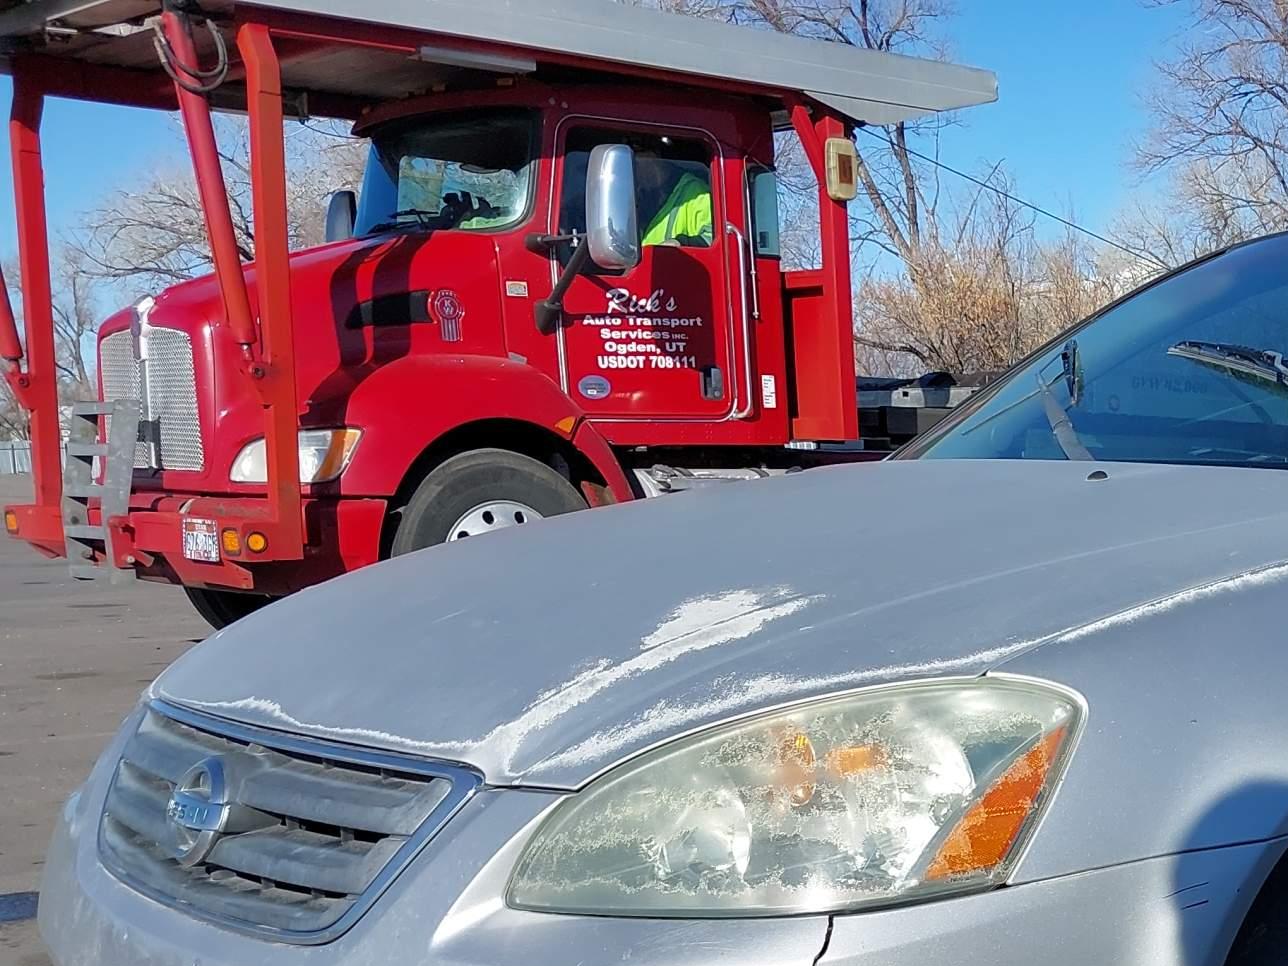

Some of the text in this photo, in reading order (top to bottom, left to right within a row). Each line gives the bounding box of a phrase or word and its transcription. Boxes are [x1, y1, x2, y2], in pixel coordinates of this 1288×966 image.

[606, 288, 677, 313] Rick's
[583, 315, 702, 328] Auto Transport
[600, 328, 670, 339] Services
[604, 341, 686, 354] Ogden, UT
[597, 356, 696, 369] USDOT 708111
